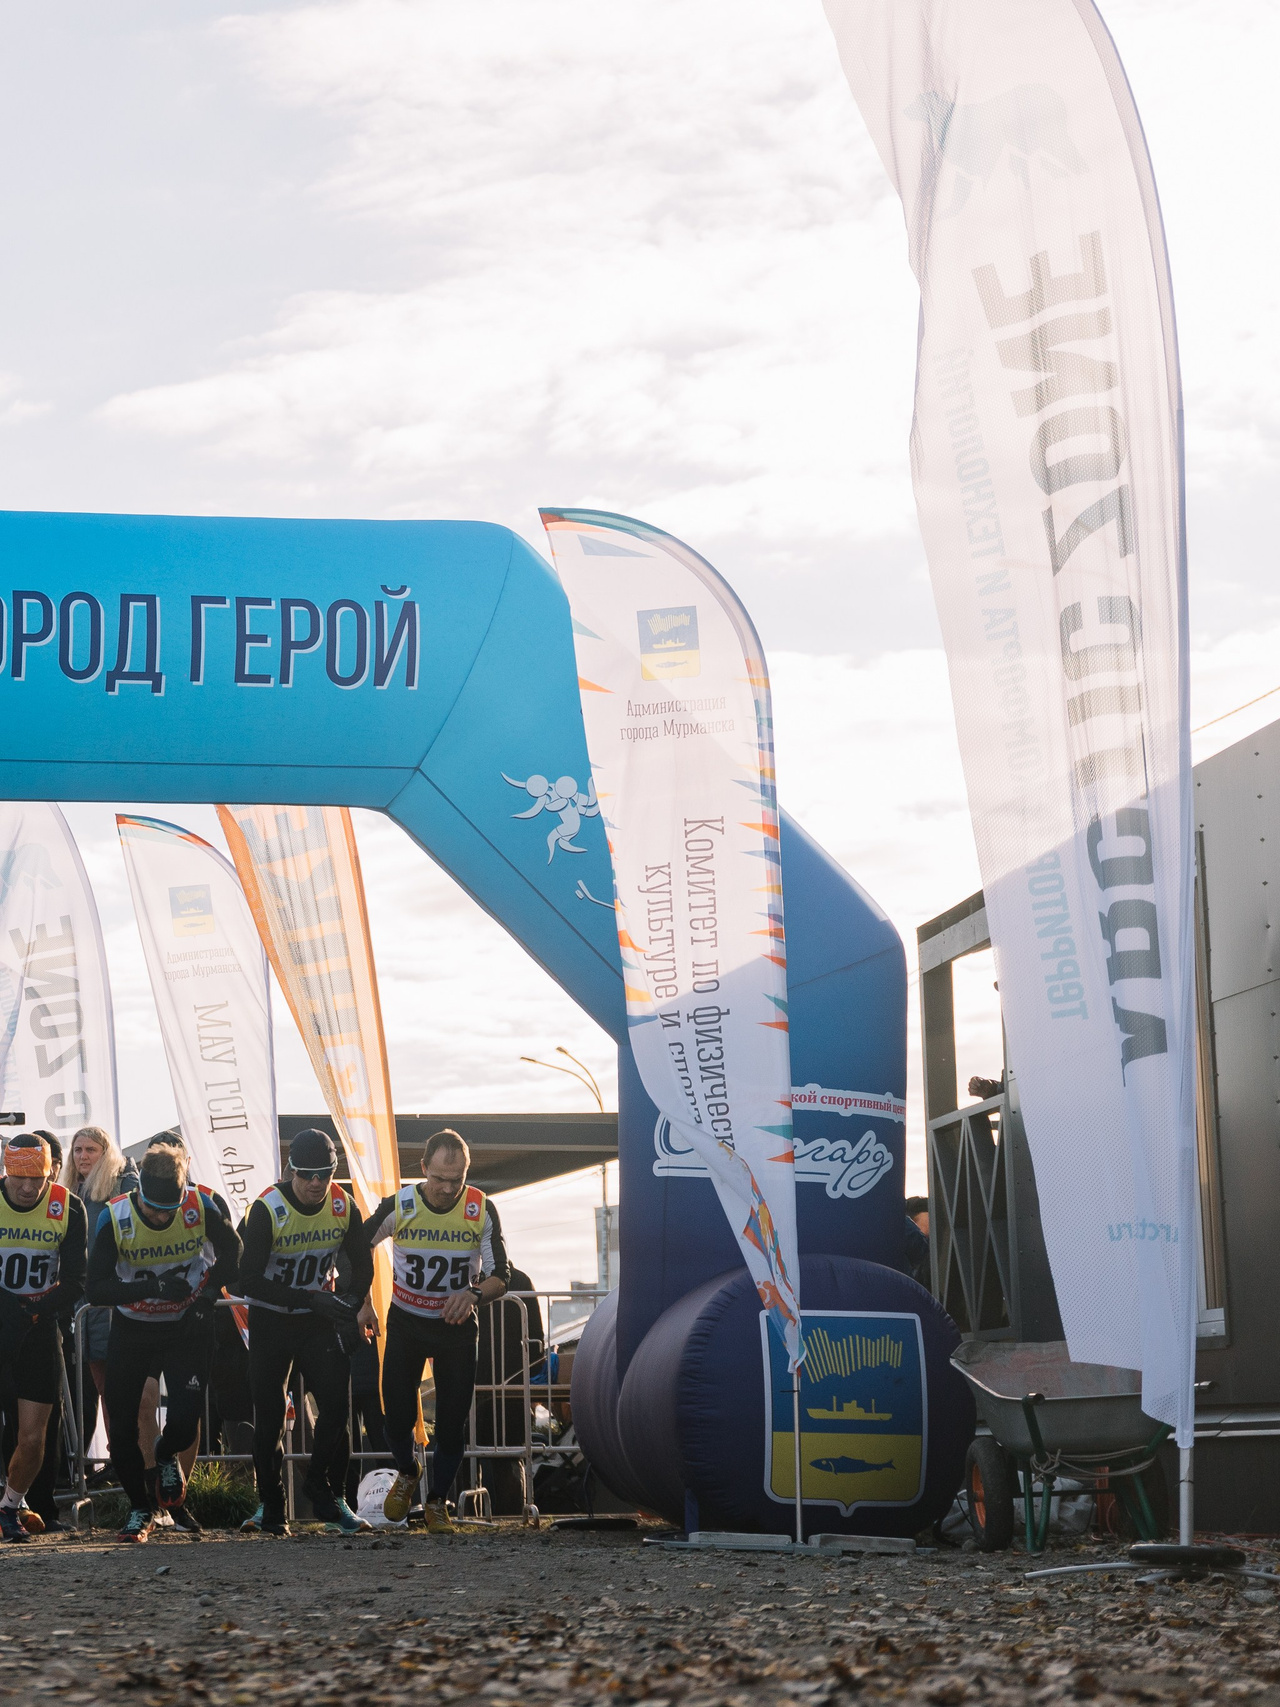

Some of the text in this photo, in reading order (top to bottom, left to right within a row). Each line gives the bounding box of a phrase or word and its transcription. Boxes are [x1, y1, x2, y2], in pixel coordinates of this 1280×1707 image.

[189, 584, 419, 690] ГЕРОЙ
[626, 697, 727, 718] Администрация
[620, 719, 735, 742] города Мурманска
[684, 816, 724, 948] Комитет
[166, 947, 235, 964] Администрация
[638, 862, 679, 999] культуре
[659, 1010, 681, 1030] и
[191, 963, 242, 979] Мурманска
[692, 960, 720, 994] по
[193, 1001, 237, 1066] МАУ
[204, 1078, 249, 1133] ГСЦ
[790, 1090, 817, 1104] кой
[820, 1095, 892, 1112] спортивный
[397, 1228, 480, 1243] МУРМАНСК
[405, 1254, 471, 1292] 325
